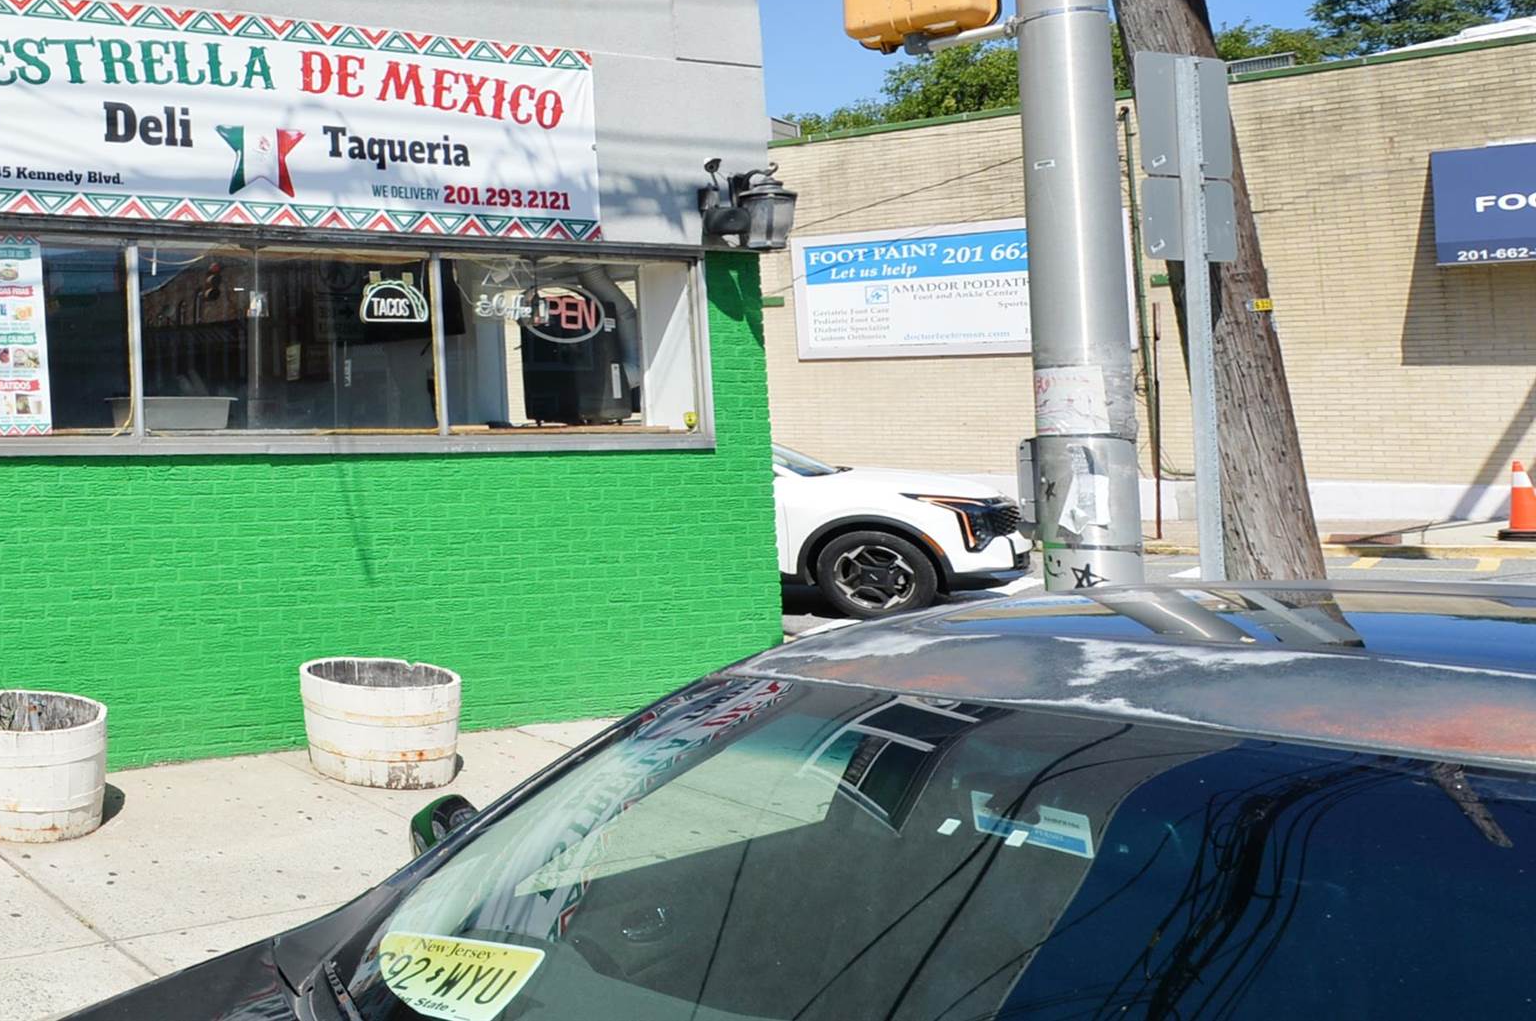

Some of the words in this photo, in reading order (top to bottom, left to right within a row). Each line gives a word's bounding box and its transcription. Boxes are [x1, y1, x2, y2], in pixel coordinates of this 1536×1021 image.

[299, 50, 365, 97] DE
[375, 60, 564, 130] MEXICO
[104, 101, 193, 148] Deli
[323, 126, 470, 168] Taqueria
[16, 167, 84, 186] Kennedy
[88, 170, 124, 185] Blvd.
[372, 185, 387, 198] WE
[390, 186, 440, 202] DELIVERY
[443, 185, 571, 211] 201.293.2121
[1475, 193, 1536, 212] FO
[808, 248, 868, 265] FOOT
[873, 243, 937, 260] PAIN?
[942, 245, 984, 264] 201
[1457, 247, 1536, 261] 201-662-
[830, 267, 856, 280] Let
[860, 267, 878, 277] us
[882, 263, 917, 278] help
[892, 282, 959, 294] AMADOR
[371, 297, 409, 317] TACOS
[534, 296, 597, 331] PEN
[415, 938, 449, 953] New
[446, 943, 495, 962] Jersey
[414, 997, 449, 1012] State
